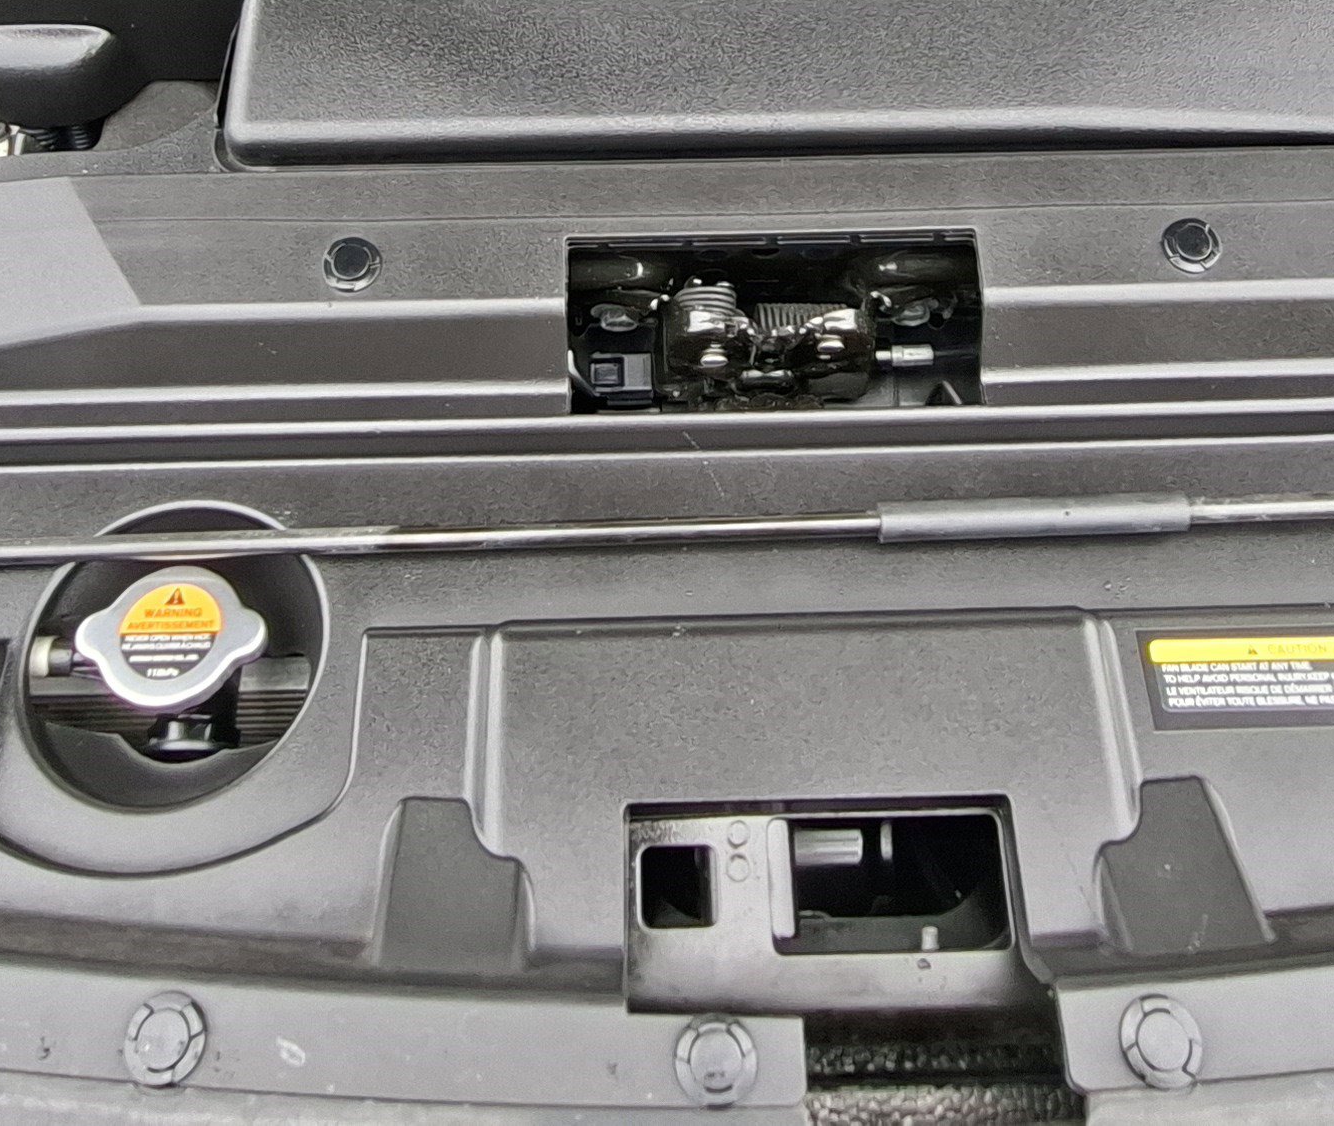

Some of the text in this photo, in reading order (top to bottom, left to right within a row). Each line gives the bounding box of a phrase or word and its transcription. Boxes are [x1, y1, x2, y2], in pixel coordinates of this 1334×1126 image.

[144, 608, 203, 618] WARNING
[127, 620, 215, 630] AVERTISSEMENT
[1267, 643, 1327, 655] CAUTION
[1161, 663, 1179, 672] FAN
[1179, 663, 1209, 672] BLADE
[1210, 662, 1229, 672] CAN
[1231, 662, 1257, 671] START
[1259, 661, 1269, 671] AT
[1271, 661, 1289, 670] ANY
[1163, 674, 1176, 683] TO
[1177, 674, 1200, 683] HELP
[1202, 673, 1228, 682] AVOID
[1230, 673, 1277, 682] PERSONAL
[1166, 686, 1178, 696] LE
[1178, 685, 1235, 695] VENTILATEUR
[1270, 685, 1283, 694] DE
[1168, 698, 1195, 707] POUR
[1227, 697, 1255, 706] TOUTE
